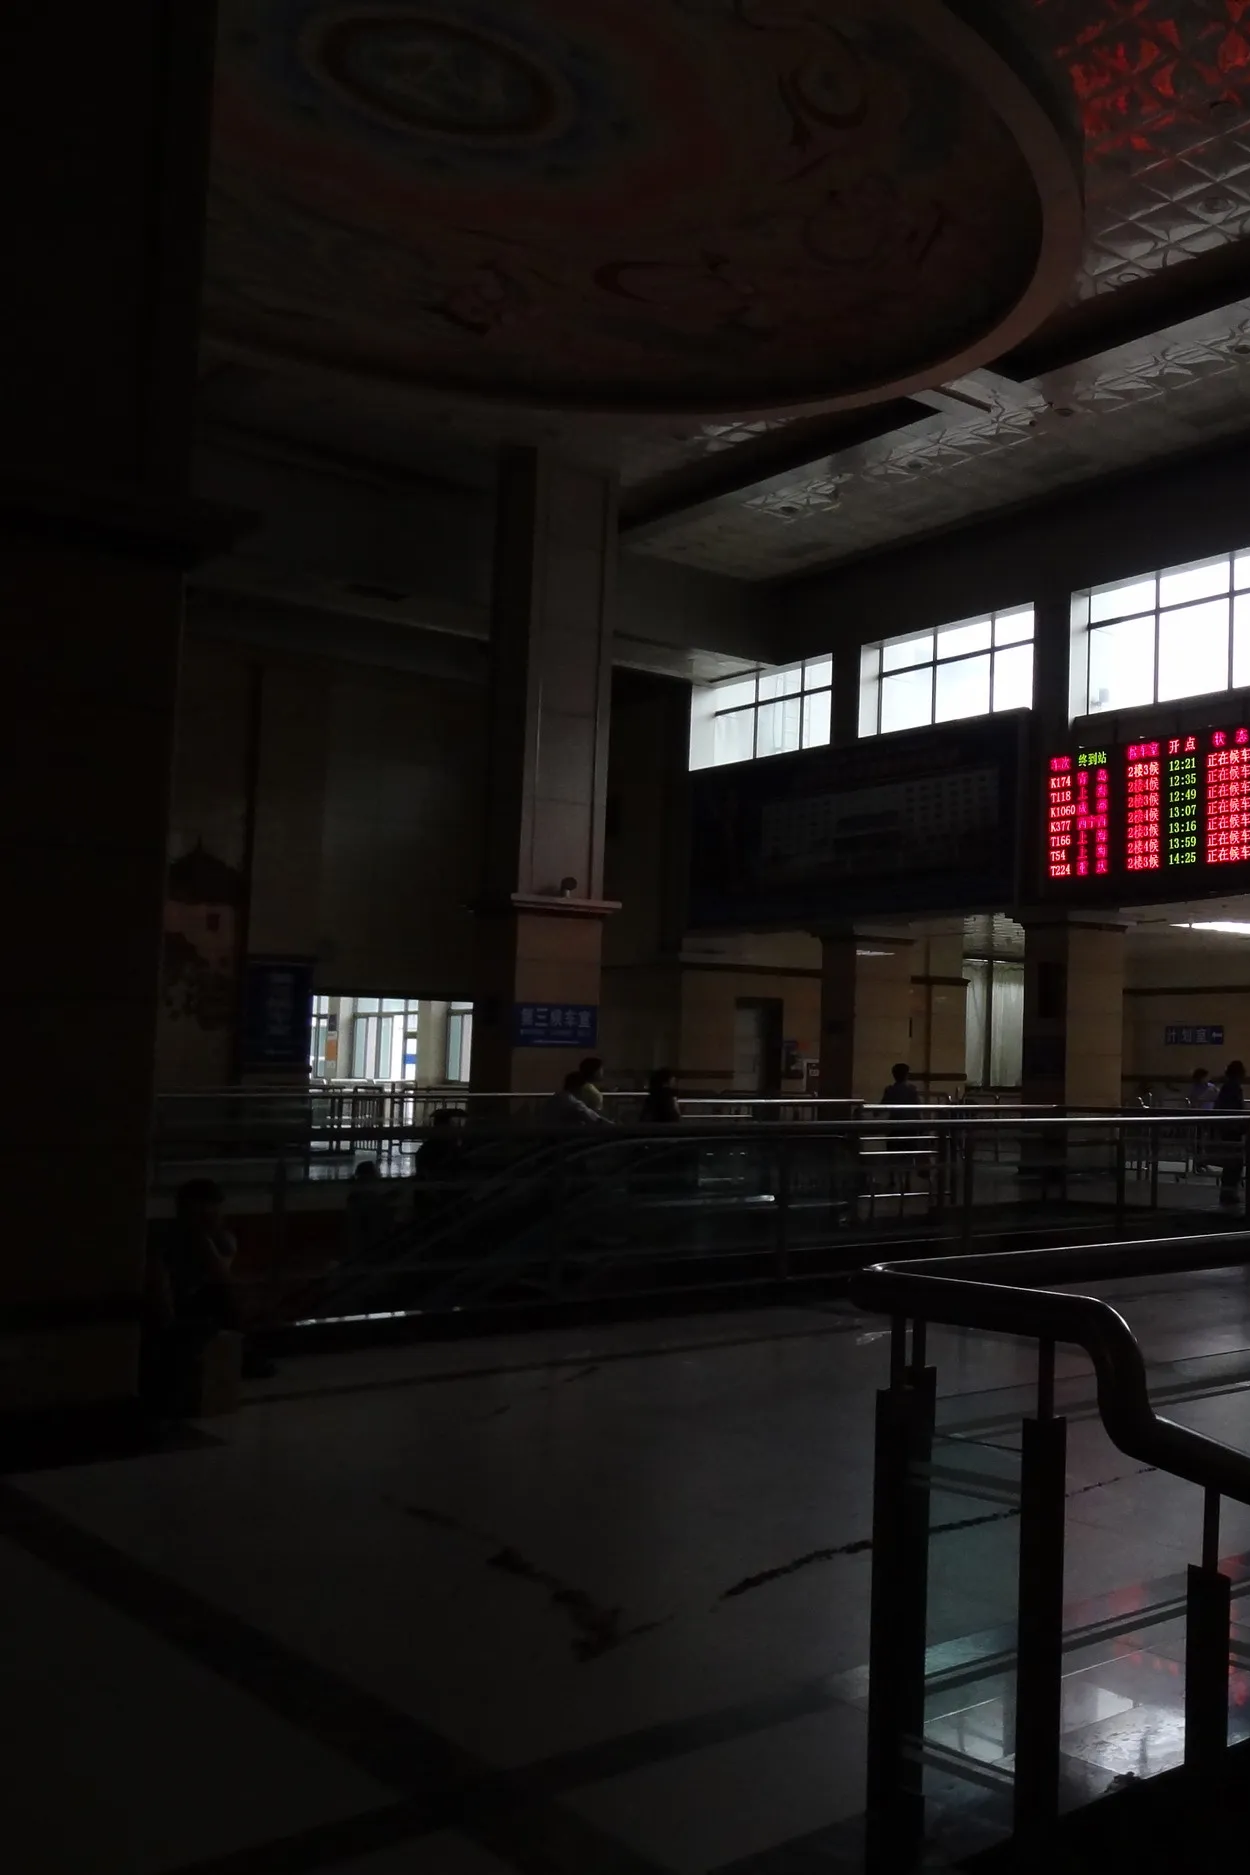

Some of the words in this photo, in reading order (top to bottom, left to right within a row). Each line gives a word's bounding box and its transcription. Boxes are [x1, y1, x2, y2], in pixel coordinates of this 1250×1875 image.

[1078, 752, 1107, 767] 终到站
[1169, 737, 1196, 754] 开点
[1212, 728, 1249, 747] 状态
[1051, 776, 1071, 789] K174
[1128, 763, 1159, 777] 2楼3候
[1169, 758, 1196, 772] 12:21
[1051, 791, 1071, 803] T118
[1169, 774, 1196, 787] 12:35
[1051, 805, 1075, 818] K1060
[1169, 789, 1197, 803] 12:49
[1051, 820, 1071, 832] K377
[1169, 805, 1197, 818] 13:07
[1051, 835, 1071, 847] T166
[1169, 821, 1197, 834] 13:16
[1051, 850, 1066, 861] T54
[1128, 840, 1159, 854] 2楼4候
[1169, 836, 1197, 850] 13:59
[1051, 864, 1071, 876] T224
[1128, 855, 1159, 869] 2楼3候
[1169, 852, 1196, 865] 14:25
